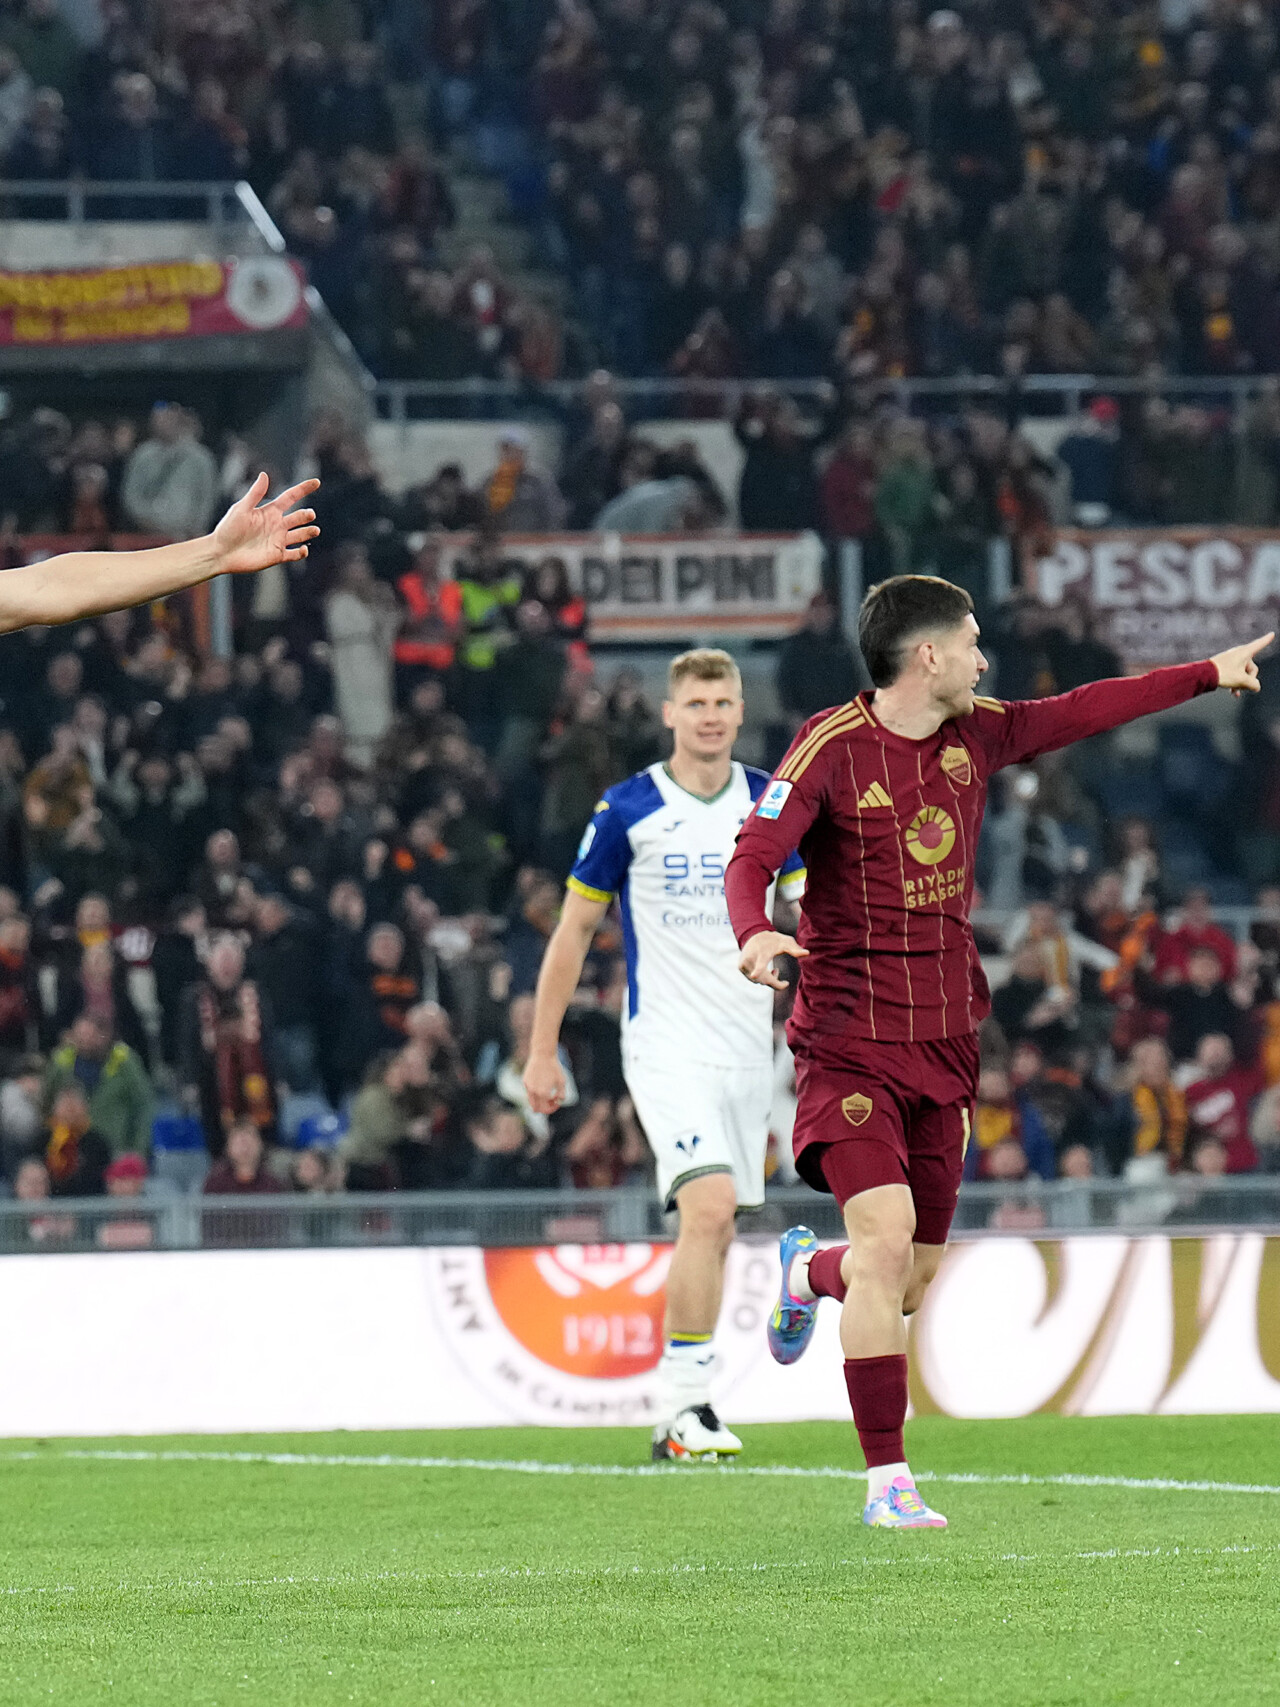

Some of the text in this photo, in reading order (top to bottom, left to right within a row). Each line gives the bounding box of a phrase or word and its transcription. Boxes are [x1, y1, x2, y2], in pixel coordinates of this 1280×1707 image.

[663, 854, 724, 880] 95
[905, 868, 965, 893] RIYADH
[906, 881, 964, 909] SEASON
[563, 1312, 656, 1356] 1912
